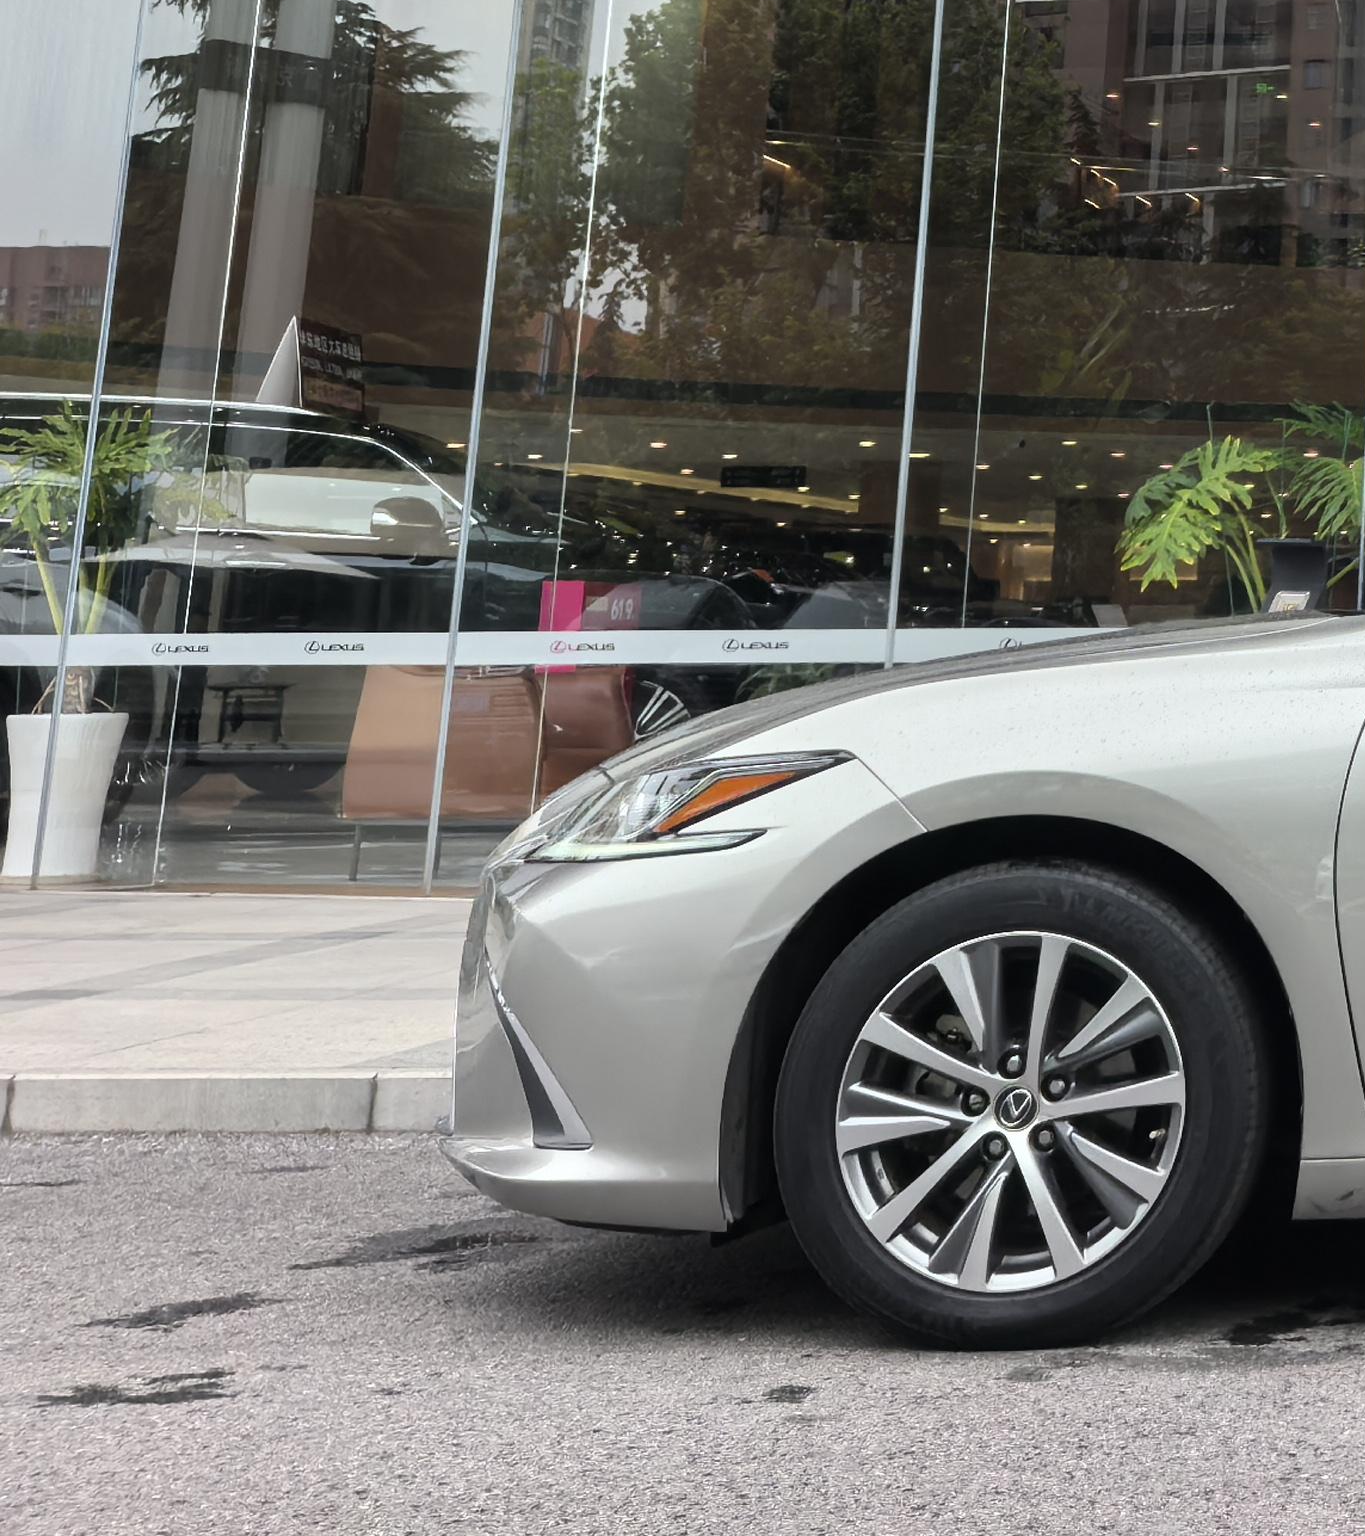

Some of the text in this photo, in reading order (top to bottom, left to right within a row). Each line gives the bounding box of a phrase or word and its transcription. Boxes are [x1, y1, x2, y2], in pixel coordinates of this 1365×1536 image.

[167, 644, 209, 653] LEXUS
[320, 643, 365, 652] LEXUS
[567, 642, 616, 652] LEXUS
[740, 640, 790, 650] LEXUS
